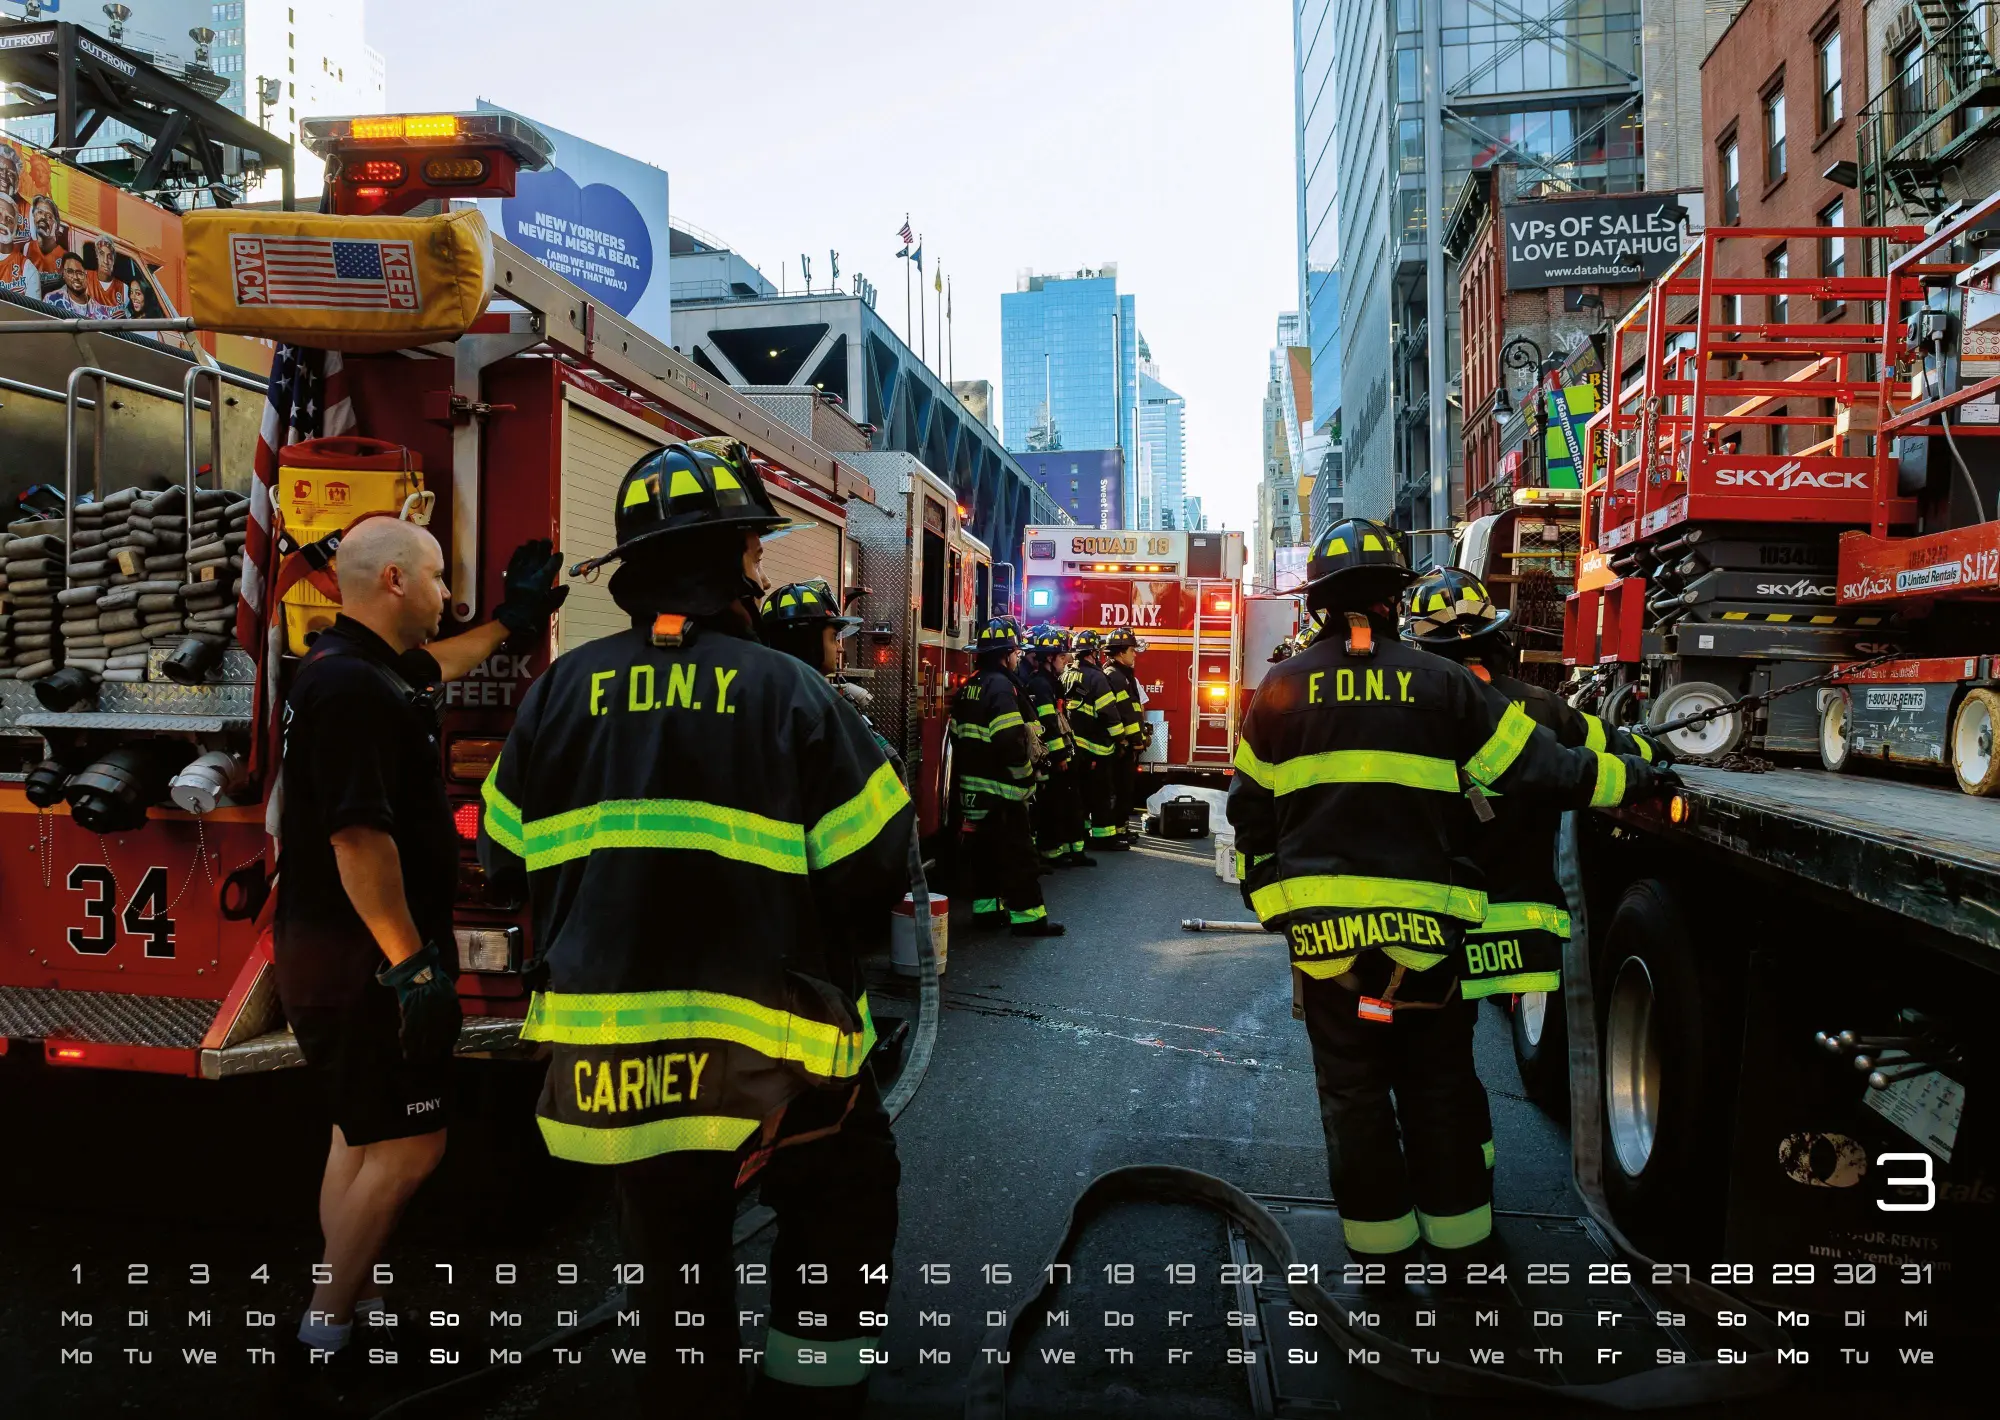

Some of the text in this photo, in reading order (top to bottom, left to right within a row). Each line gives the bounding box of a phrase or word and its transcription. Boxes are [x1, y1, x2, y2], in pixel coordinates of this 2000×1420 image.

[0, 34, 51, 48] UTFRONT
[80, 39, 134, 75] OUTFRONT
[535, 211, 625, 252] NEW YORKERS
[1510, 213, 1676, 241] VPs OF SALES
[518, 220, 640, 270] NEVER MISS A BEAT.
[1512, 235, 1678, 262] LOVE DATAHUG
[235, 240, 267, 304] BACK
[536, 257, 628, 292] TO KEEP IT THAT WAY.)
[546, 248, 615, 277] (AND WE INTEND
[384, 247, 415, 309] KEEP
[1715, 461, 1869, 491] SKYJACK
[1100, 479, 1108, 530] Sweet long
[1072, 536, 1170, 556] SQUAD 18
[1907, 567, 1958, 586] United Rentals
[1962, 548, 1999, 584] SJ12
[1756, 579, 1836, 598] SKYJAC
[1843, 577, 1892, 600] SKYJACK
[1100, 603, 1162, 627] F.D.N.Y.
[469, 654, 532, 679] ACK
[446, 681, 517, 706] FEET
[1145, 684, 1164, 694] FEET
[1868, 693, 1923, 706] 1-800-UR-RENTS
[66, 863, 176, 959] 34
[1291, 911, 1446, 957] SCHUMACHER
[1466, 939, 1524, 975] BORI
[574, 1052, 709, 1115] CARNEY
[406, 1097, 442, 1116] FDNY
